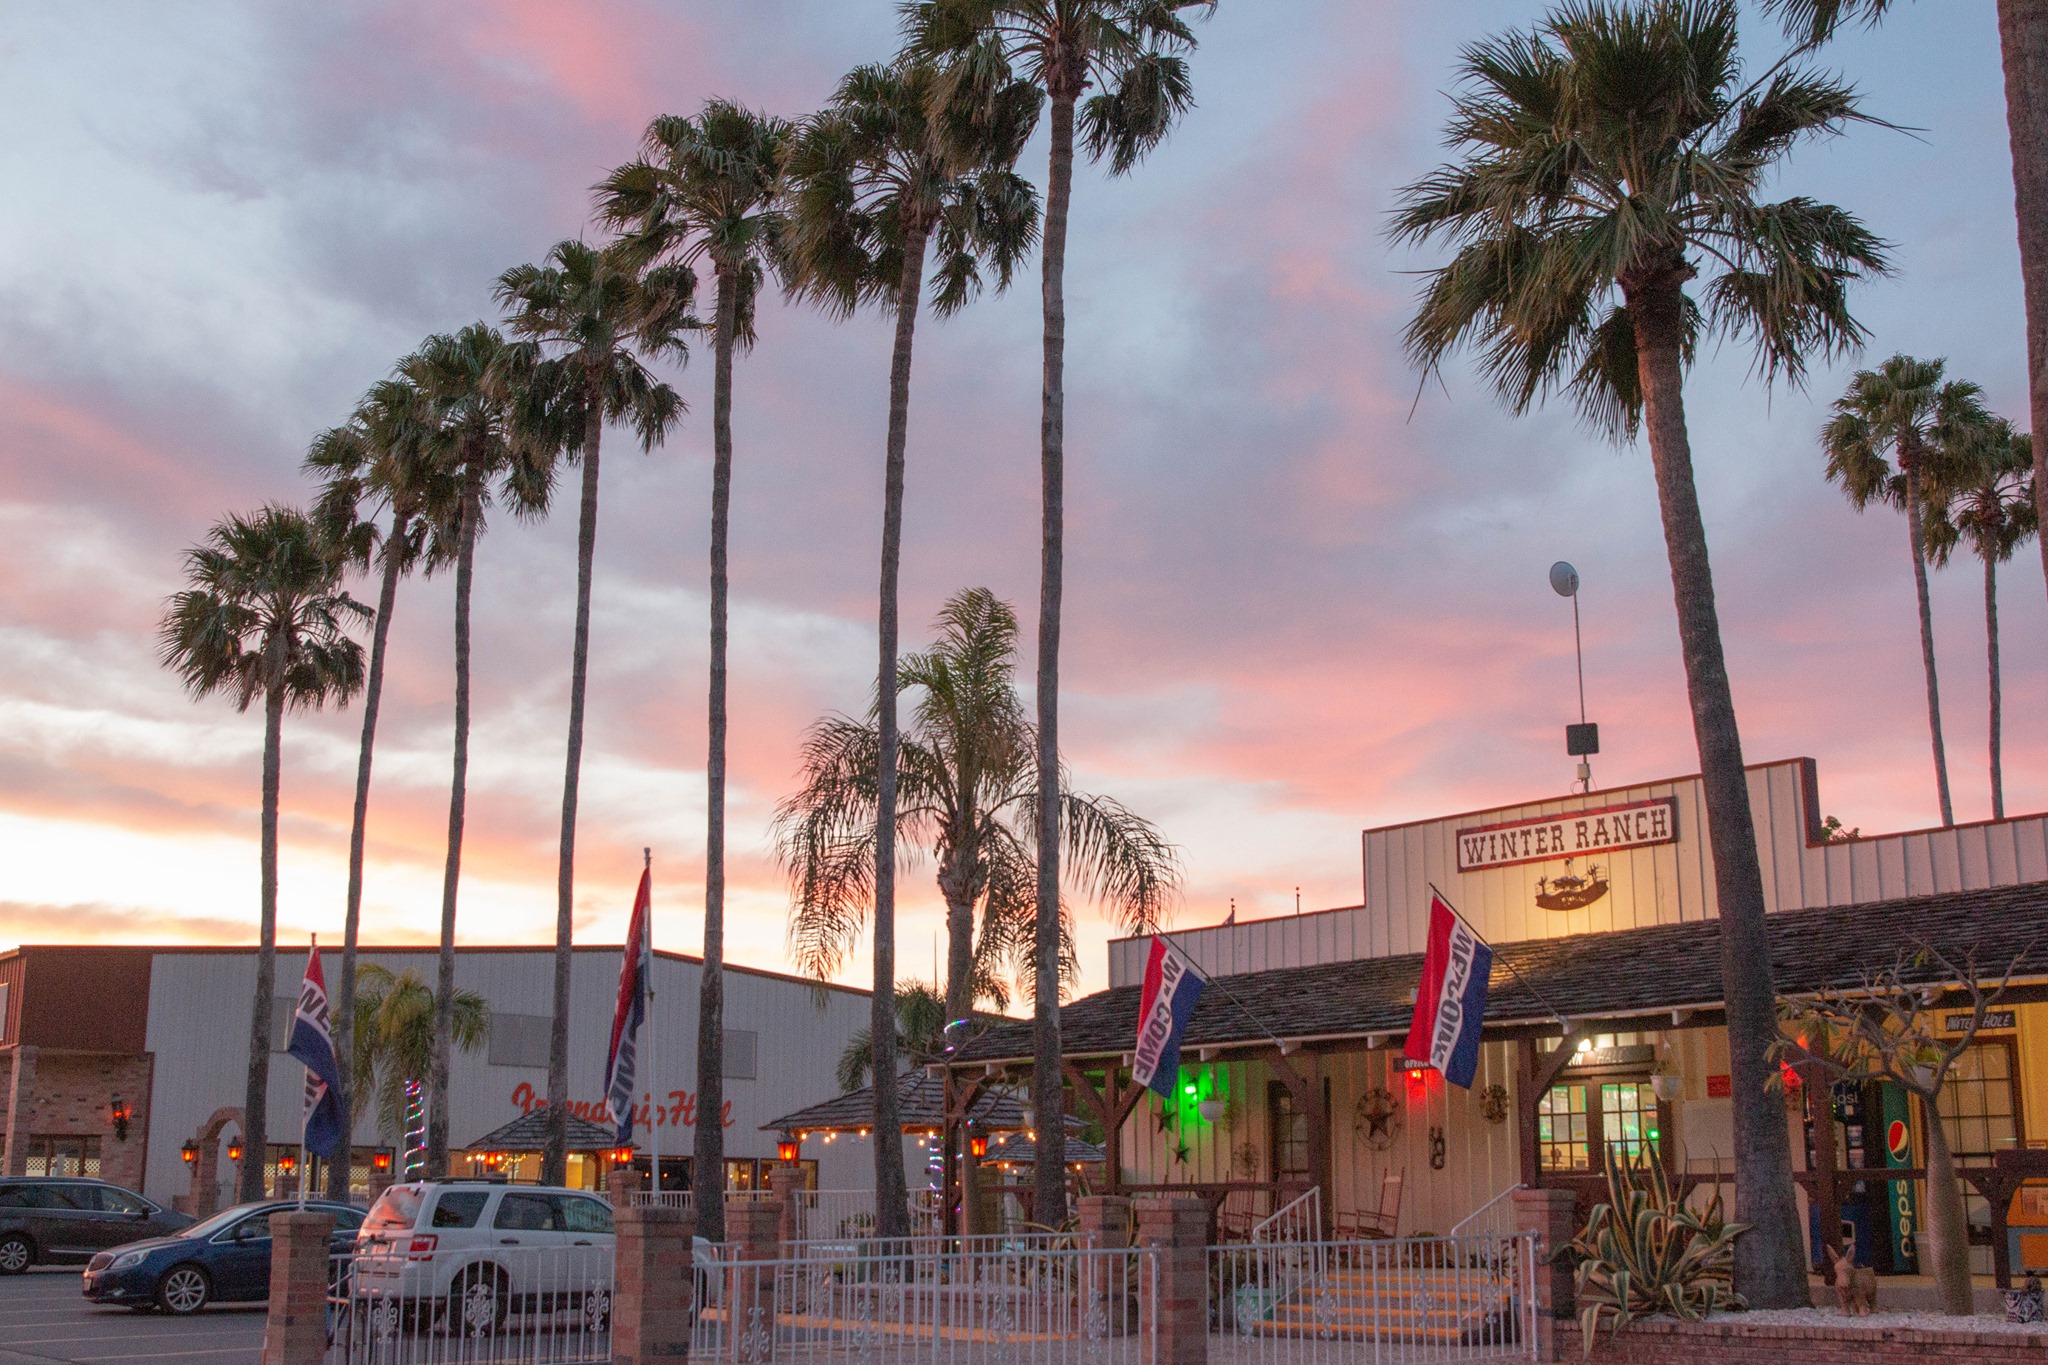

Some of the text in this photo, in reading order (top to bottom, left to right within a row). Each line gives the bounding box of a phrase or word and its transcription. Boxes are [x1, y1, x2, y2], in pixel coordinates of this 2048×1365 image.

[1464, 808, 1667, 864] WINTER RANCH
[1135, 953, 1182, 1080] WCOME
[1982, 1013, 2010, 1028] HOLE
[1896, 1179, 1914, 1258] peps
